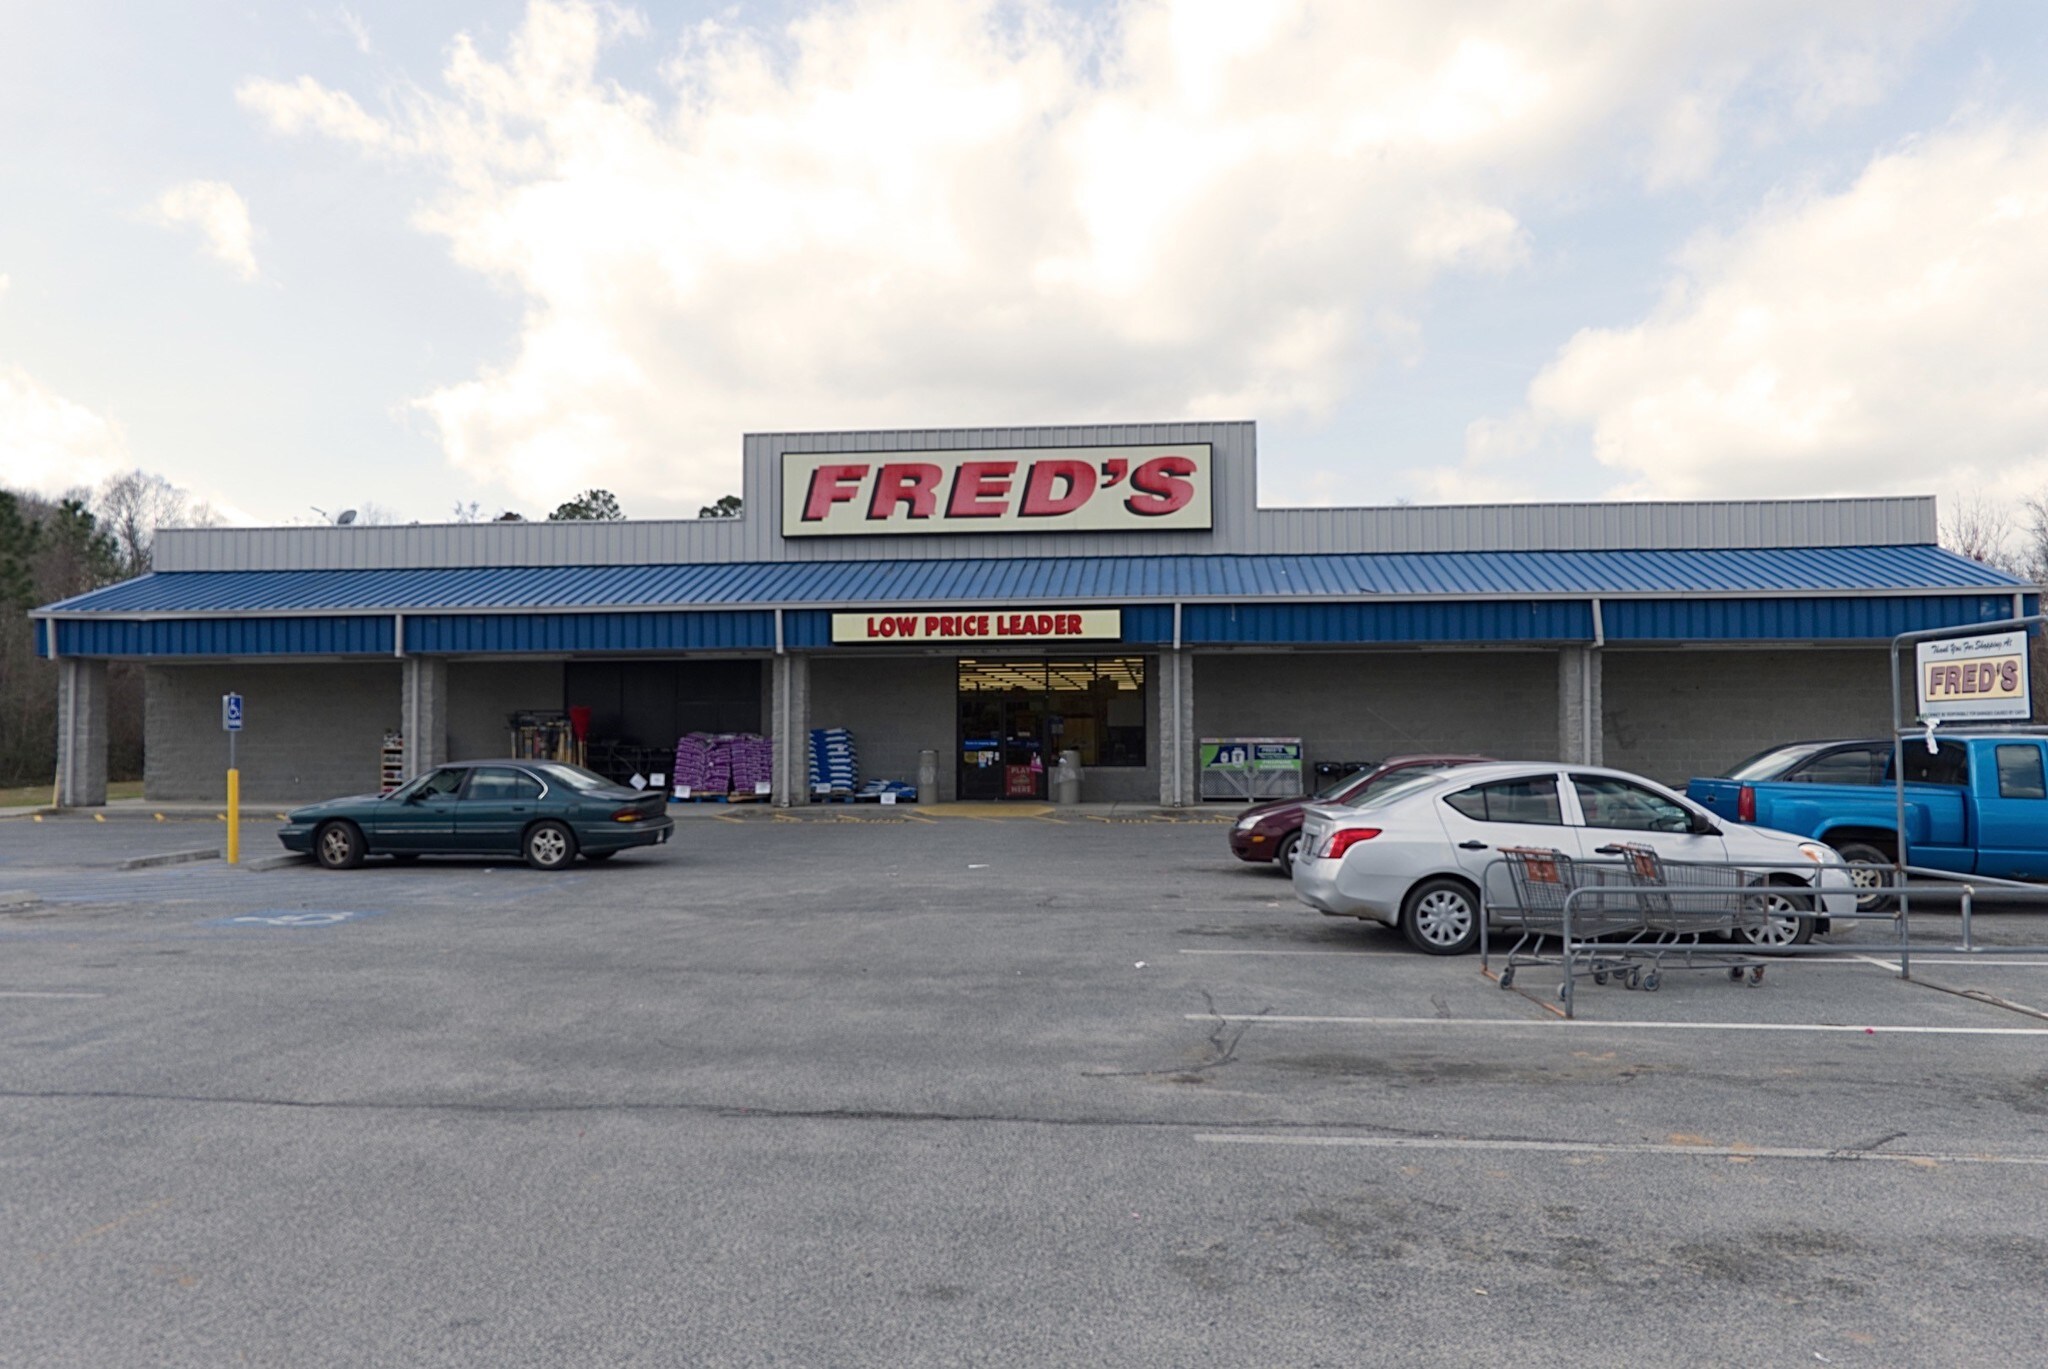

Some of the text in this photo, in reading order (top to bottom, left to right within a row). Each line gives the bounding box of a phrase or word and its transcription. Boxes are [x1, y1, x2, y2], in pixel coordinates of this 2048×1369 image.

[801, 456, 1198, 522] FRED'S
[867, 614, 1083, 637] LOW PRICE LEADER
[1931, 644, 1949, 654] Thank
[1950, 643, 1962, 655] You
[1964, 641, 1974, 653] For
[1974, 639, 2003, 651] Shopping
[1930, 660, 2019, 695] FRED'S
[1010, 766, 1031, 774] PLAY
[1010, 785, 1032, 793] HERE
